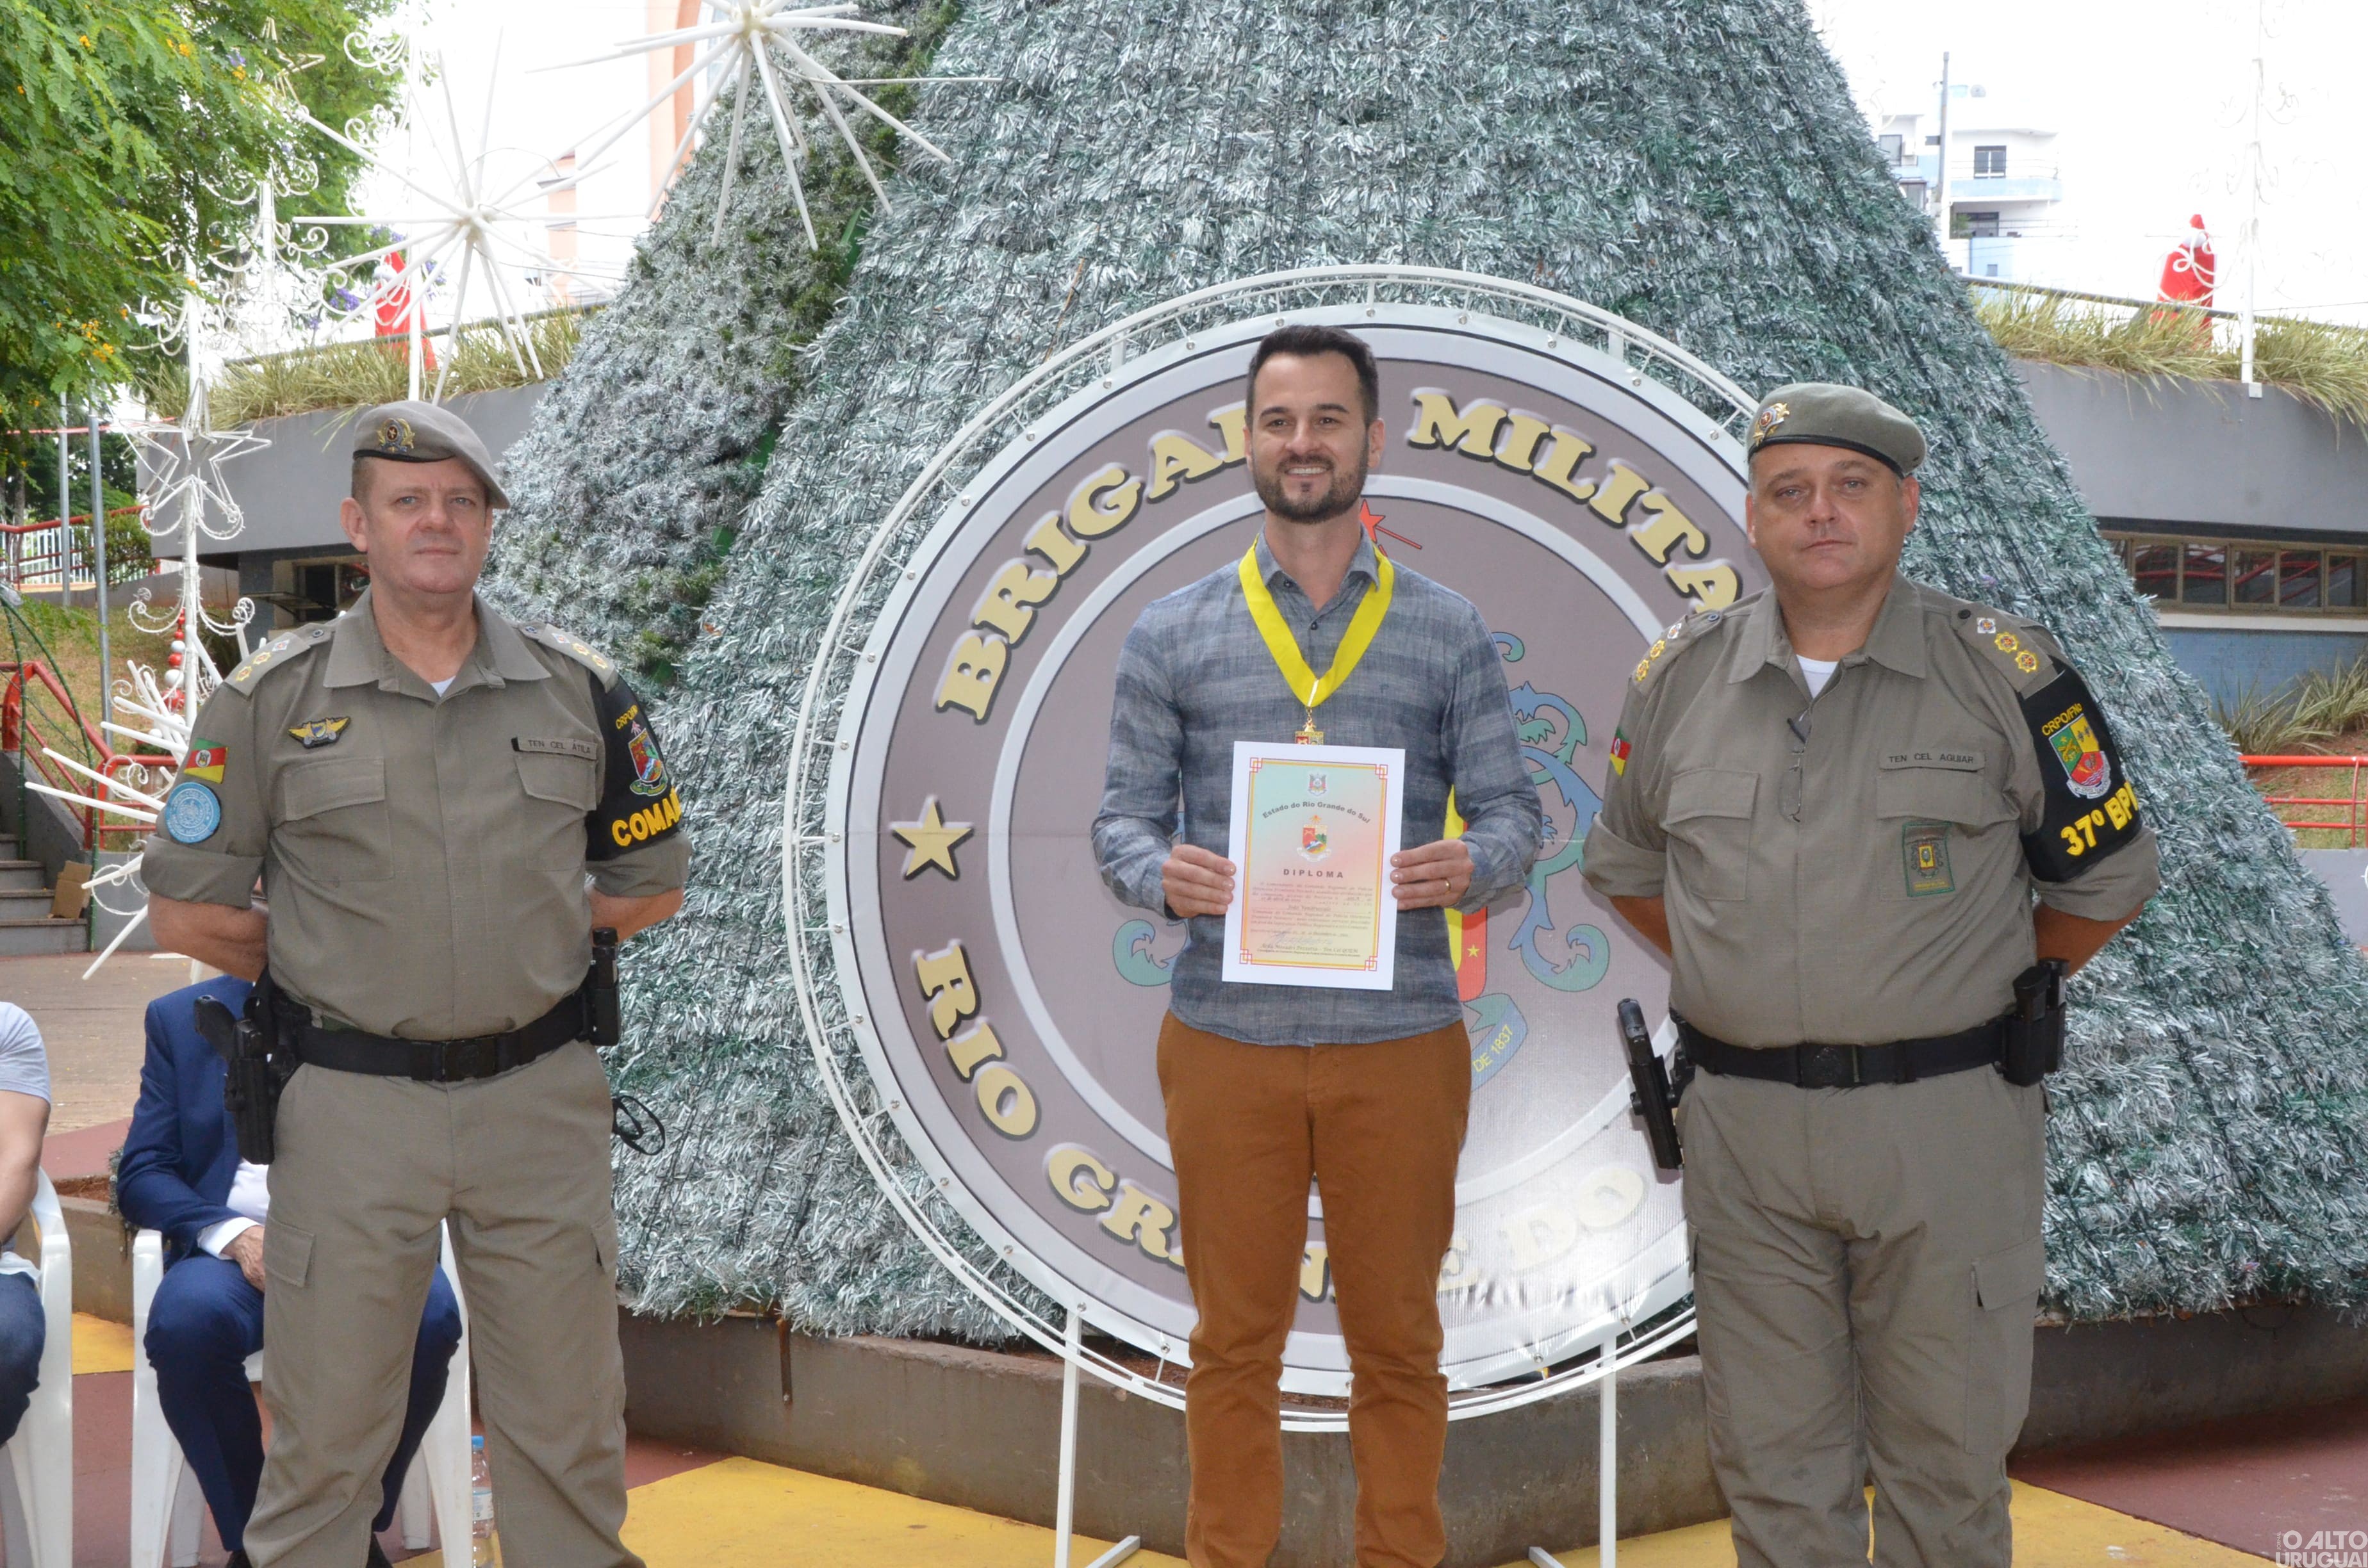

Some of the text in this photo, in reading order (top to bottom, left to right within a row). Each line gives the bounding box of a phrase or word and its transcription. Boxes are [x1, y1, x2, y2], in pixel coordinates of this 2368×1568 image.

[1407, 388, 1743, 612] MILITA
[528, 739, 545, 747] TEN
[550, 740, 566, 749] CEL
[1939, 753, 1974, 764] AGUIAR
[1262, 804, 1289, 819] Estado
[1317, 802, 1345, 812] Grande
[1358, 812, 1371, 824] Sul
[1283, 869, 1344, 878] DIPLOMA
[913, 940, 1041, 1141] RIO
[1473, 1025, 1513, 1073] DE 1837
